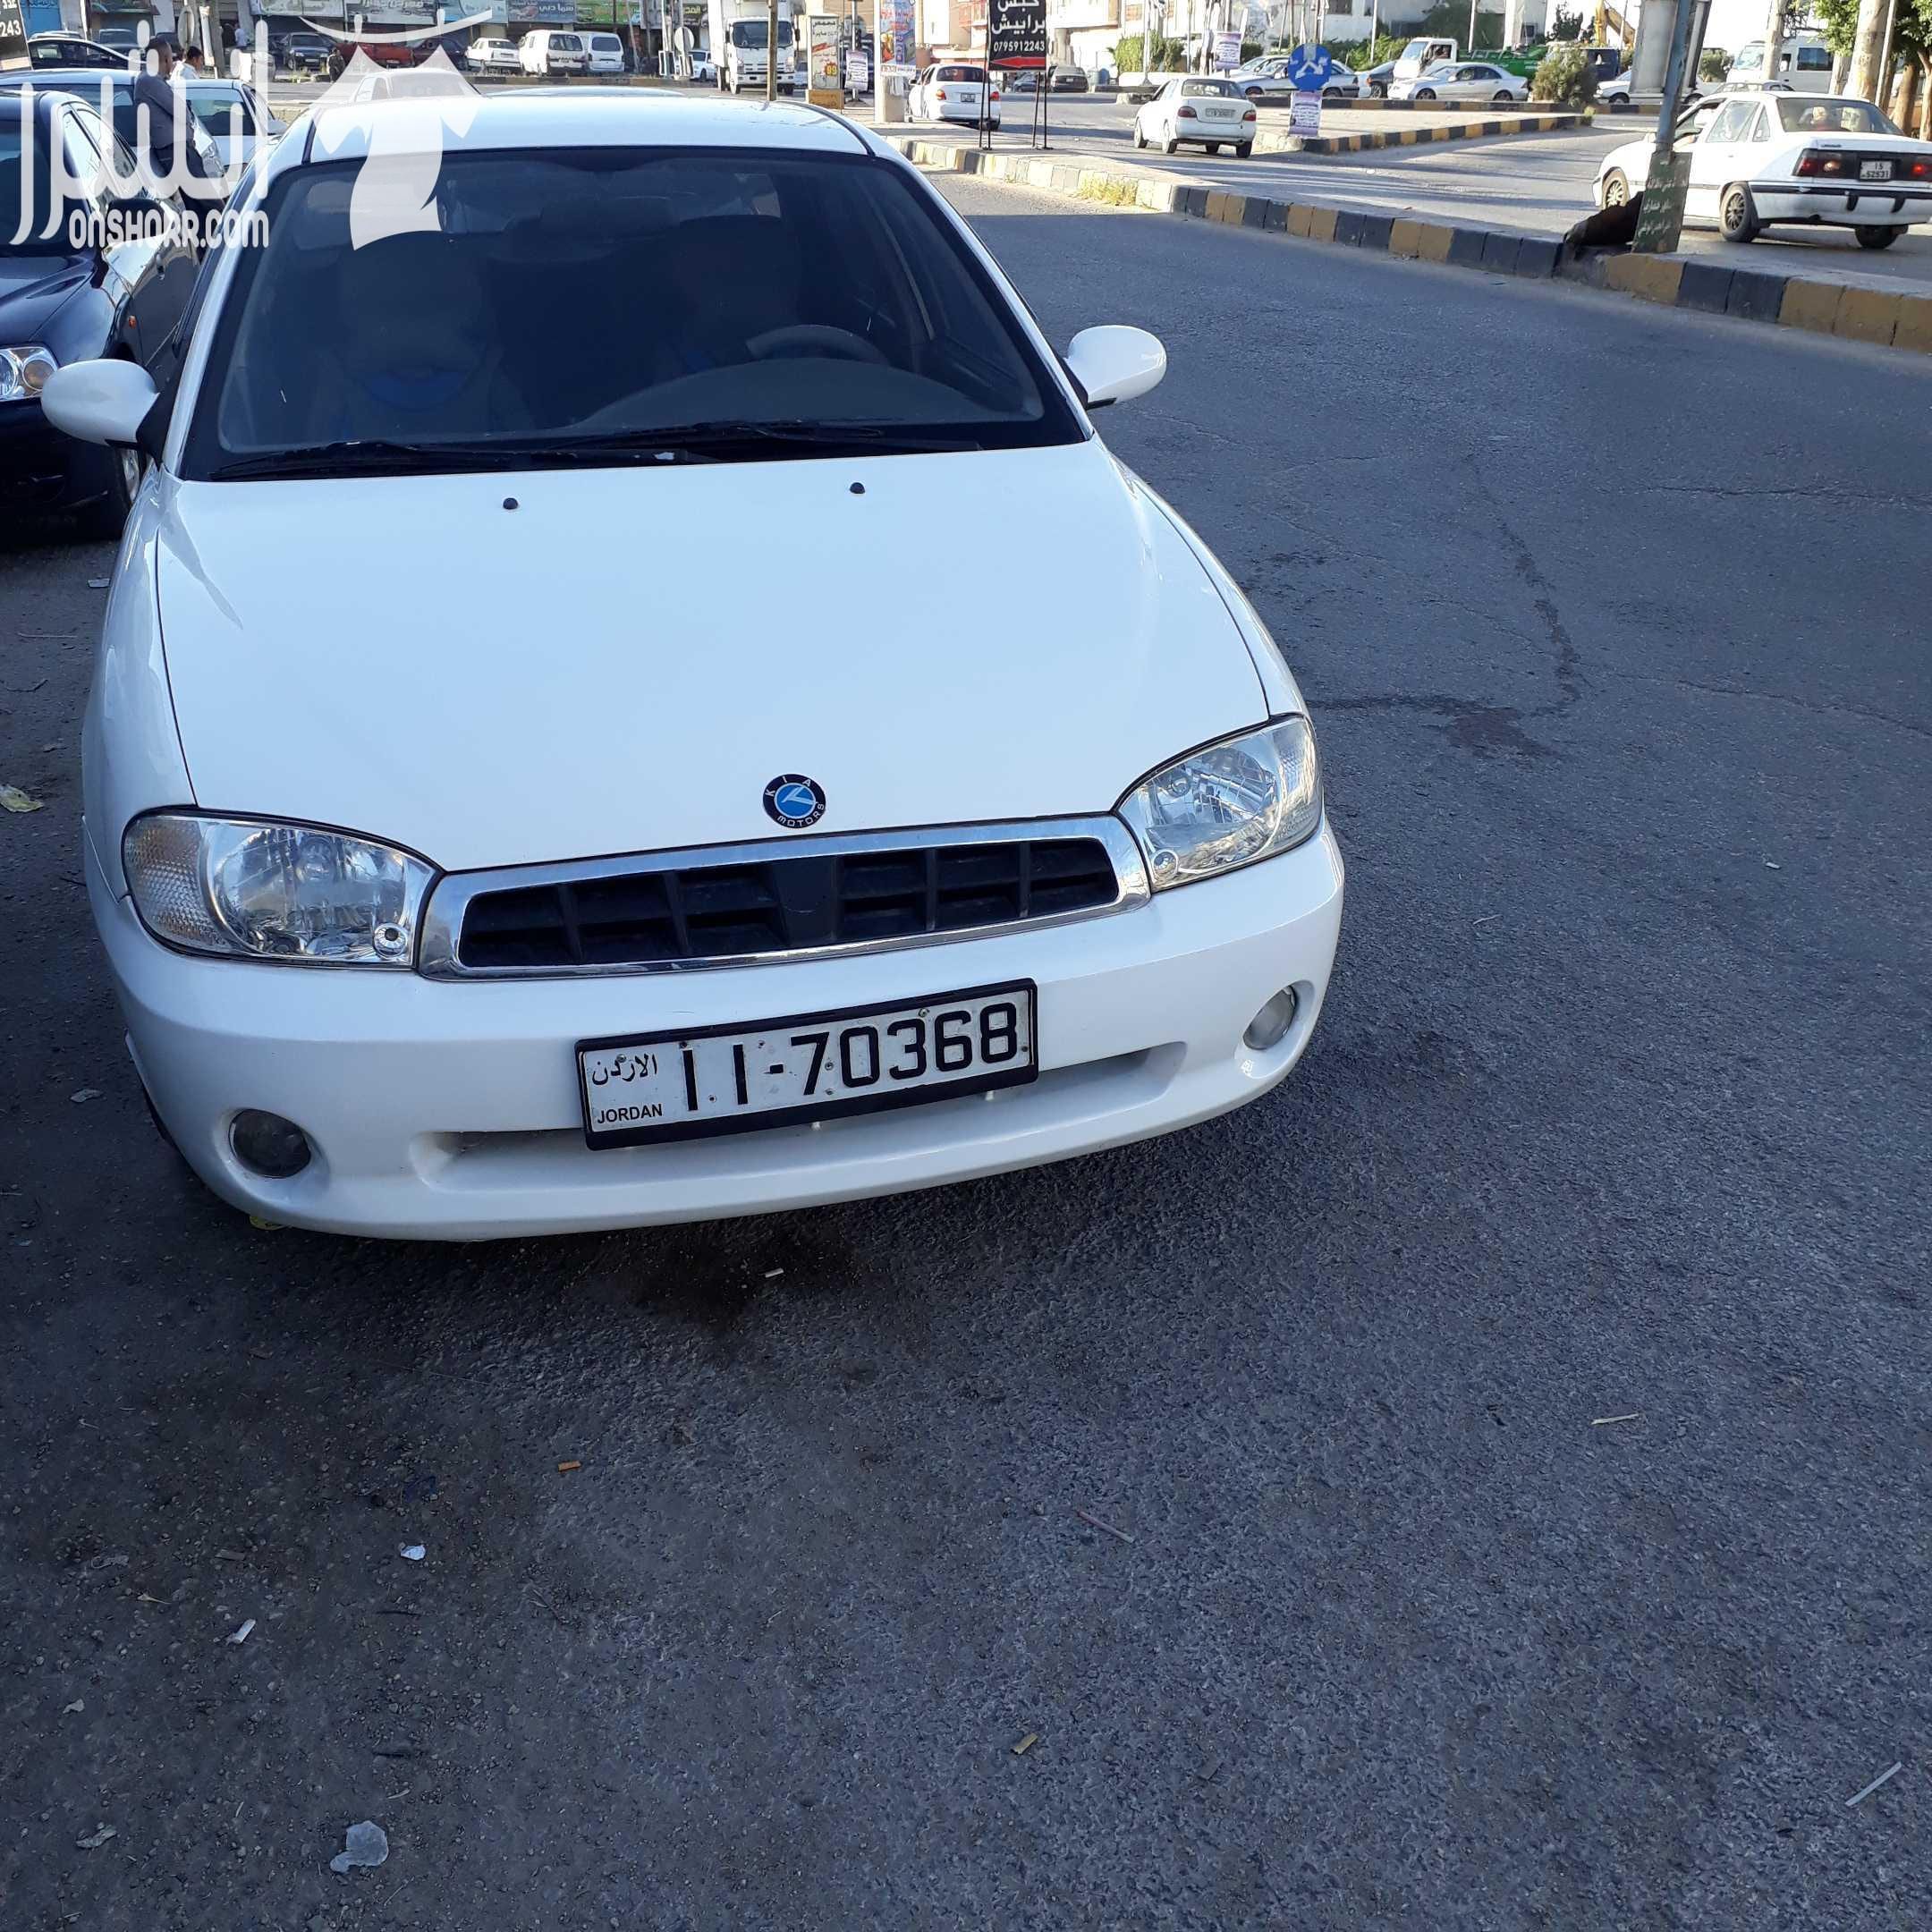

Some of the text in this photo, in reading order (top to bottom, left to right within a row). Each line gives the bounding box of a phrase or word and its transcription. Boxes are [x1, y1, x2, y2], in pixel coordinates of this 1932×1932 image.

[991, 13, 1046, 35] برابيش
[993, 40, 1046, 52] 0795912243
[826, 65, 837, 75] 99
[765, 775, 811, 797] KIA
[776, 803, 825, 827] MOTORS
[597, 1103, 663, 1124] JORDAN
